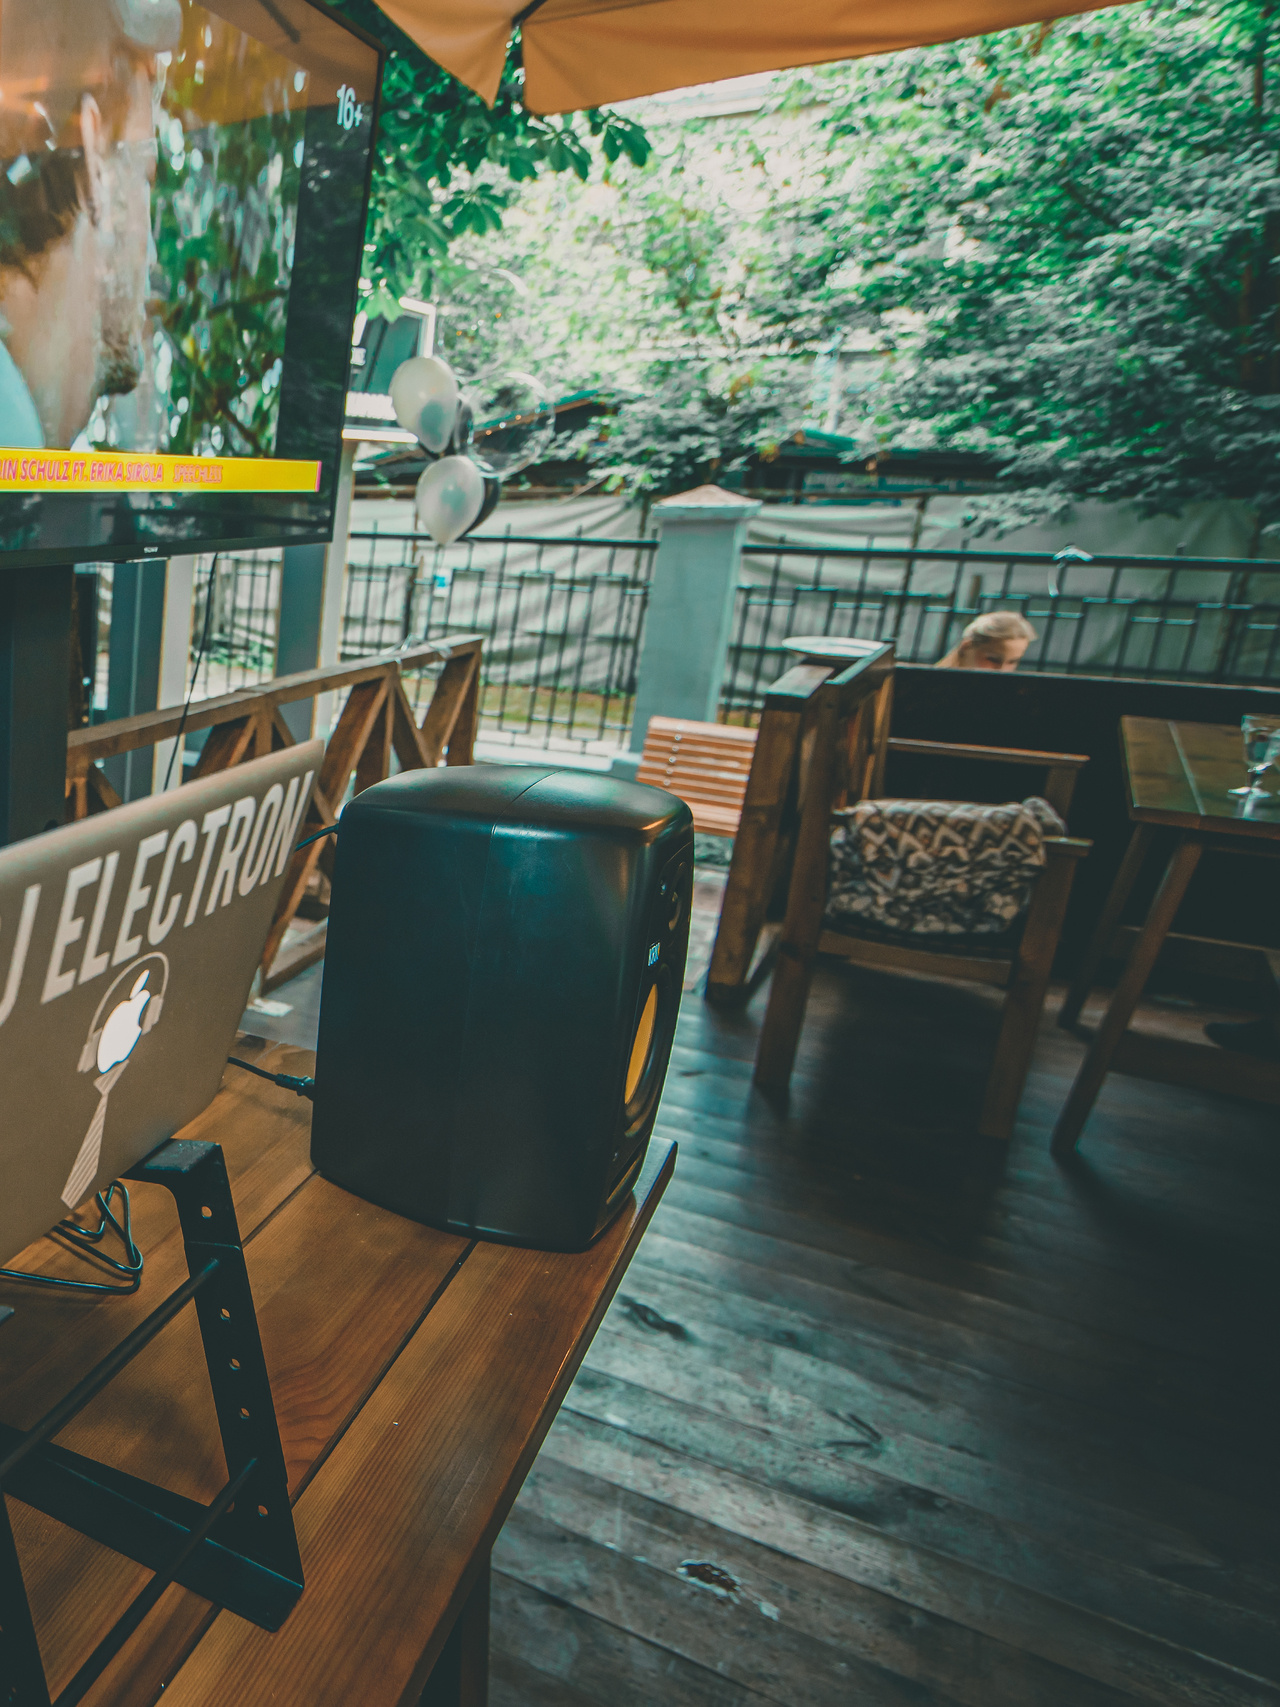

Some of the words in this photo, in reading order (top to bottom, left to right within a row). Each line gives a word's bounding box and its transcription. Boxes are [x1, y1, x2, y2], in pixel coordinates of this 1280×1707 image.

[336, 83, 363, 130] 16+
[20, 458, 71, 482] SCHULZ
[71, 460, 88, 482] FT.
[89, 461, 123, 482] ERIKA
[125, 461, 163, 483] SIROLA
[40, 769, 315, 1005] ELECTRON
